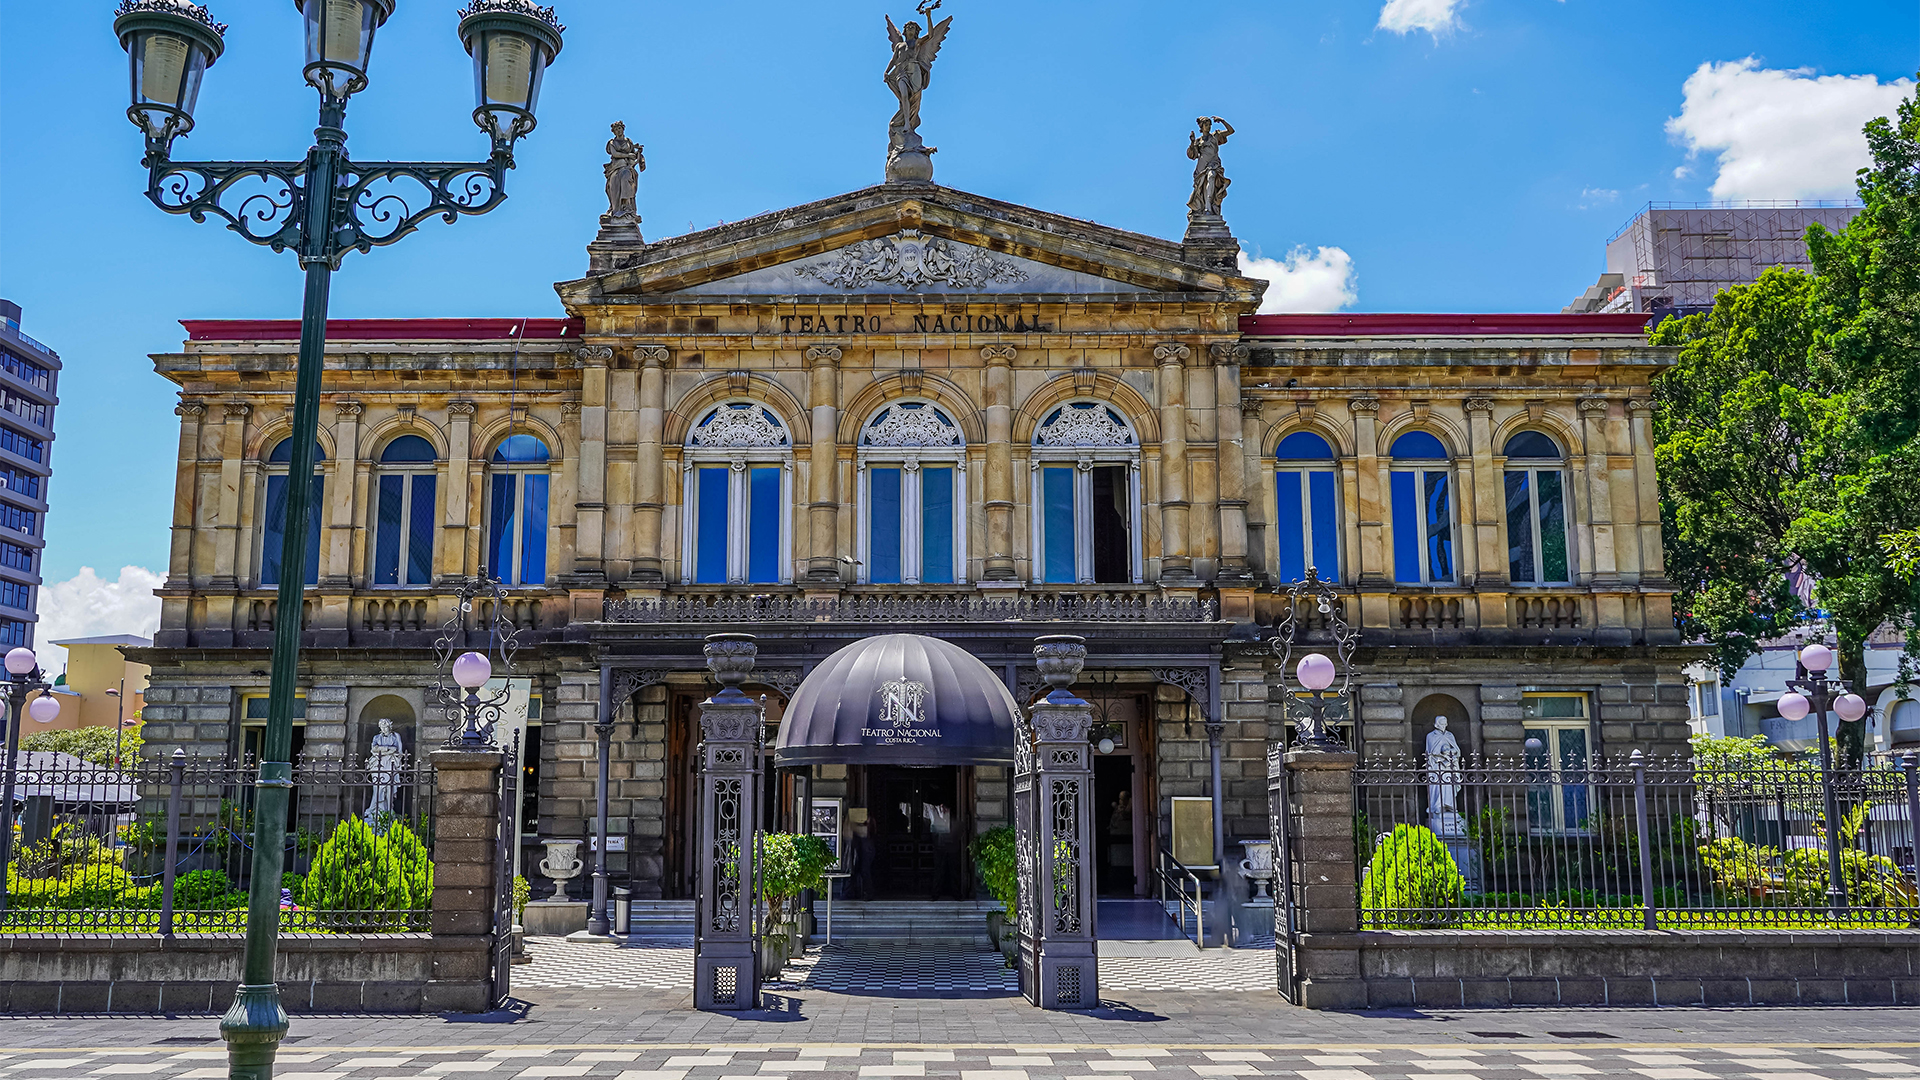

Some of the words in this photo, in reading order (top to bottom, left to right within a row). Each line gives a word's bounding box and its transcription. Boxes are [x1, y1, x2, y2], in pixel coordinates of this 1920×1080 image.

[780, 314, 881, 333] TEATRO
[913, 314, 1046, 333] NACIONAL
[861, 728, 894, 737] TEATRO
[897, 729, 942, 737] NACIONAL
